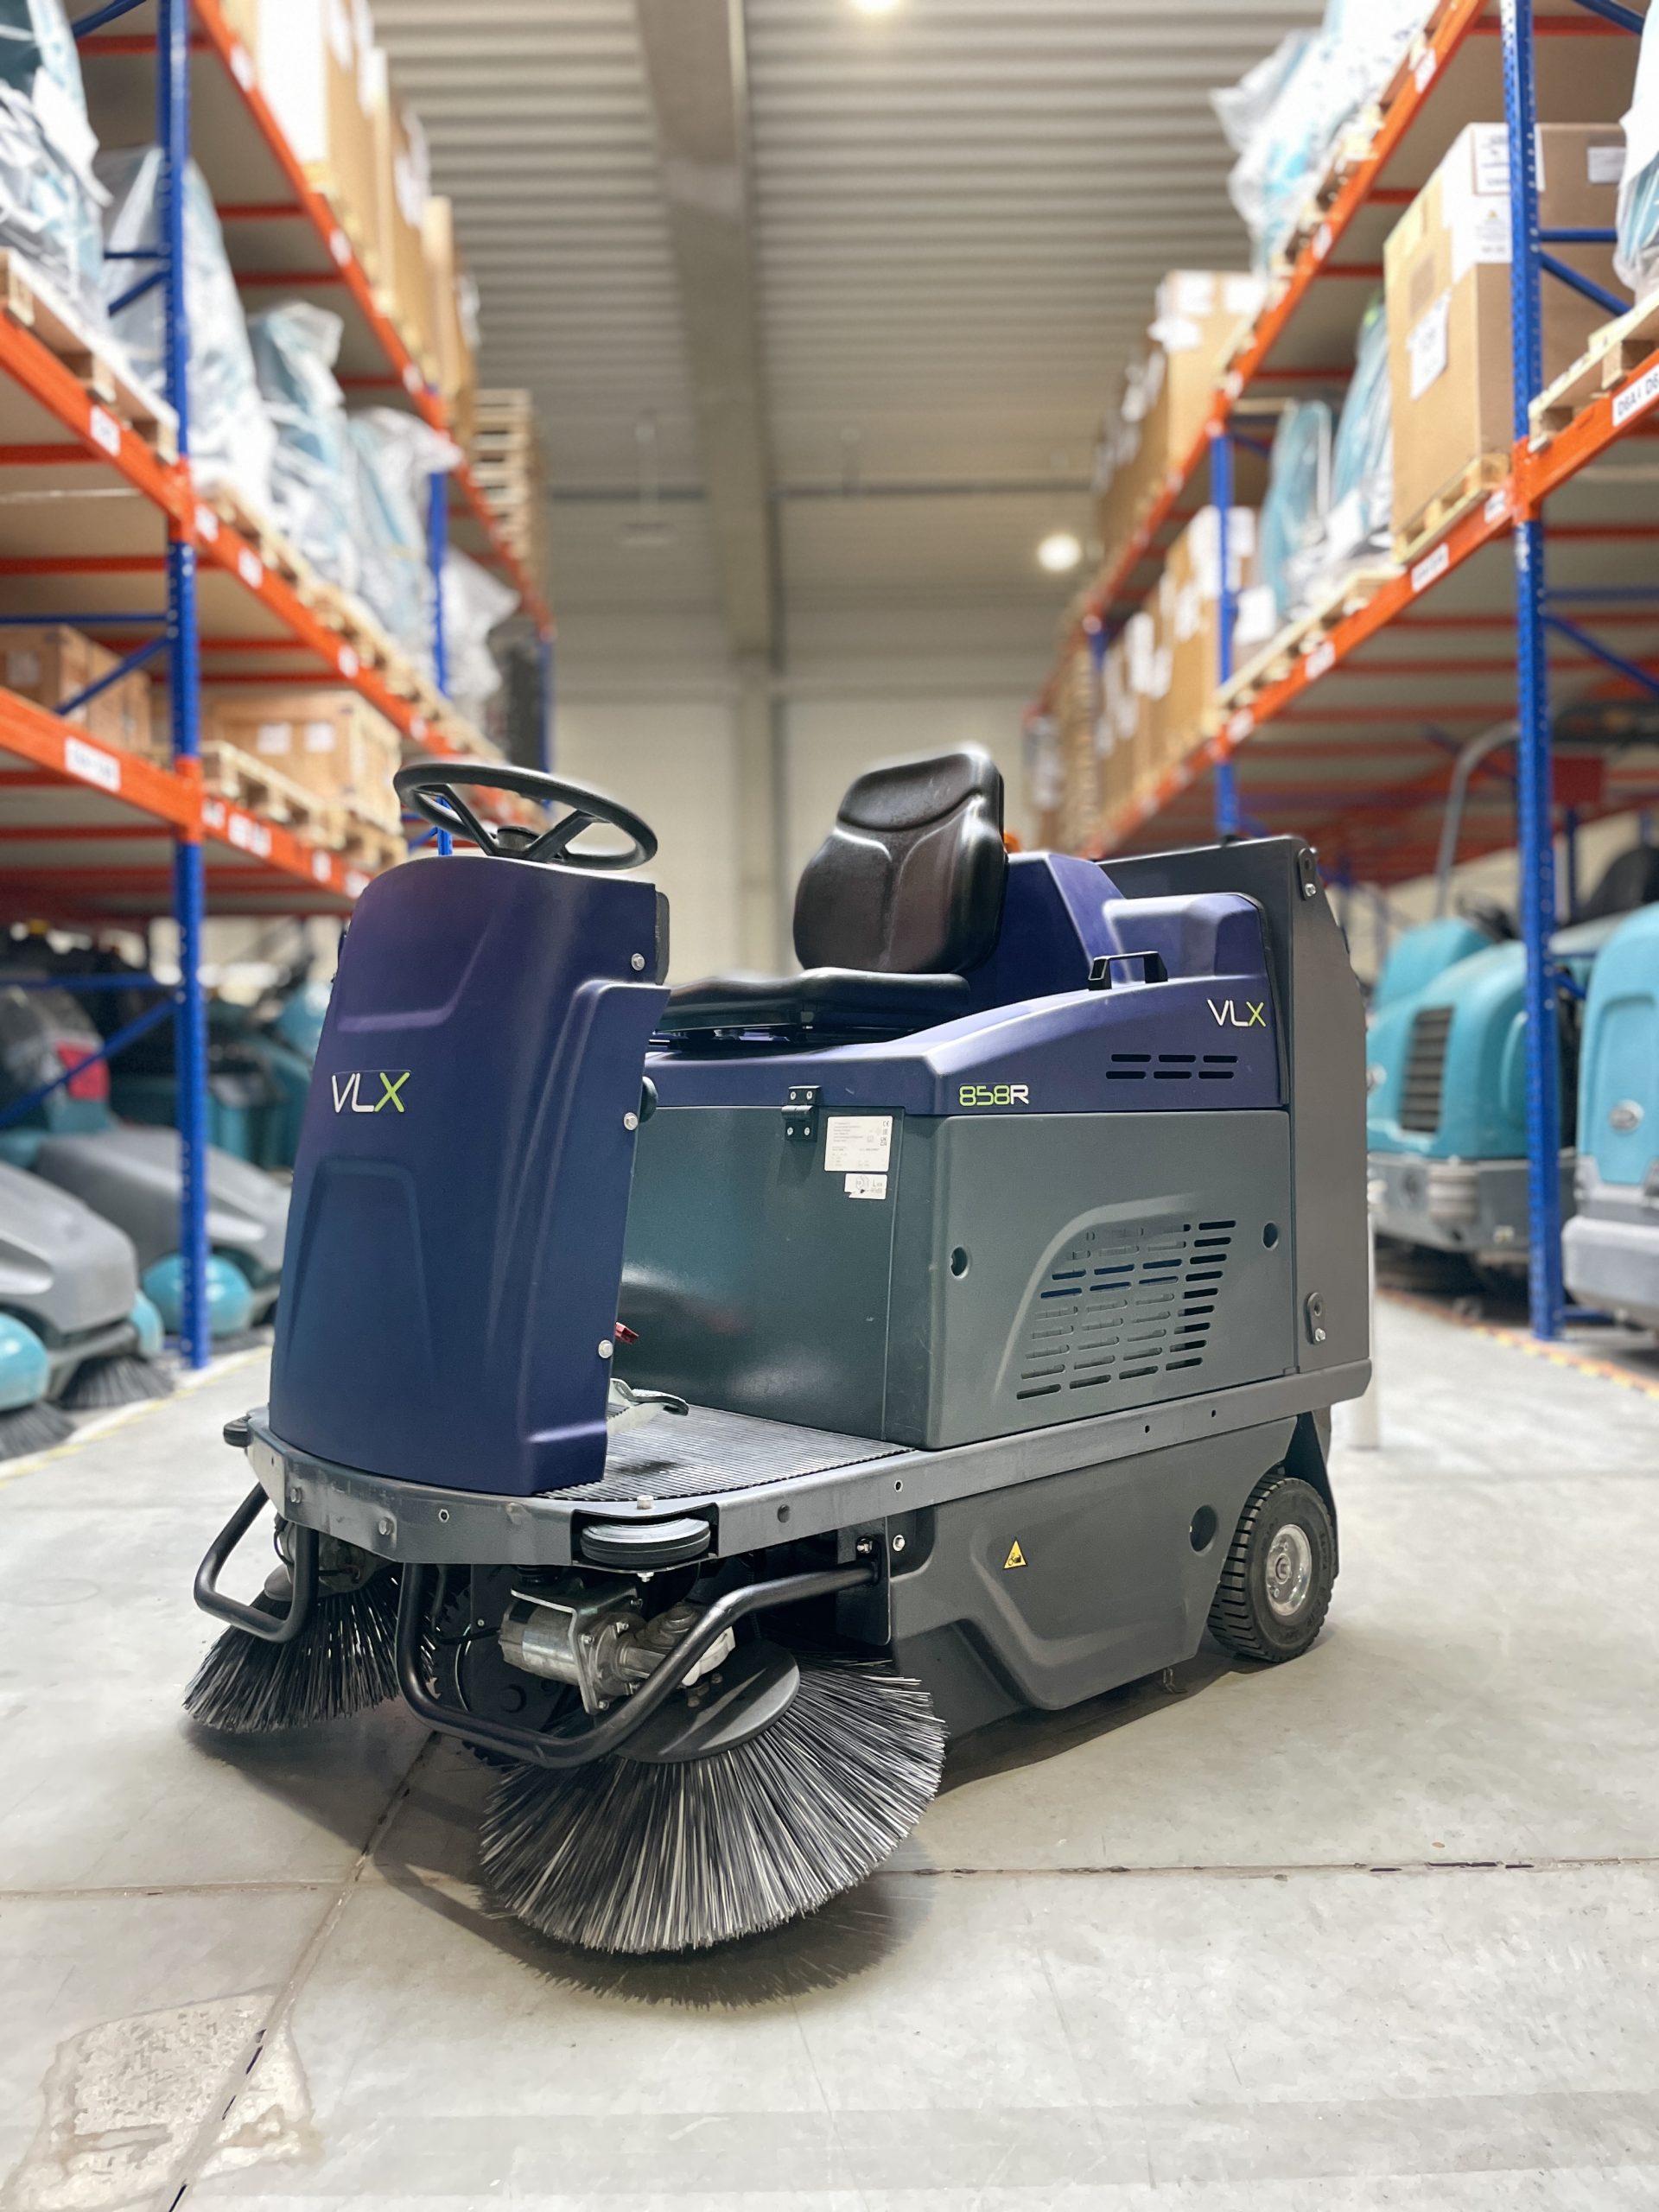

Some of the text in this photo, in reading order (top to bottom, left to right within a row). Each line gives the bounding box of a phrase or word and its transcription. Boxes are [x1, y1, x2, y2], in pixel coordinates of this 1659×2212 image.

[1207, 999, 1267, 1027] VLX
[331, 1071, 410, 1113] VLX
[959, 1084, 1030, 1107] 858R
